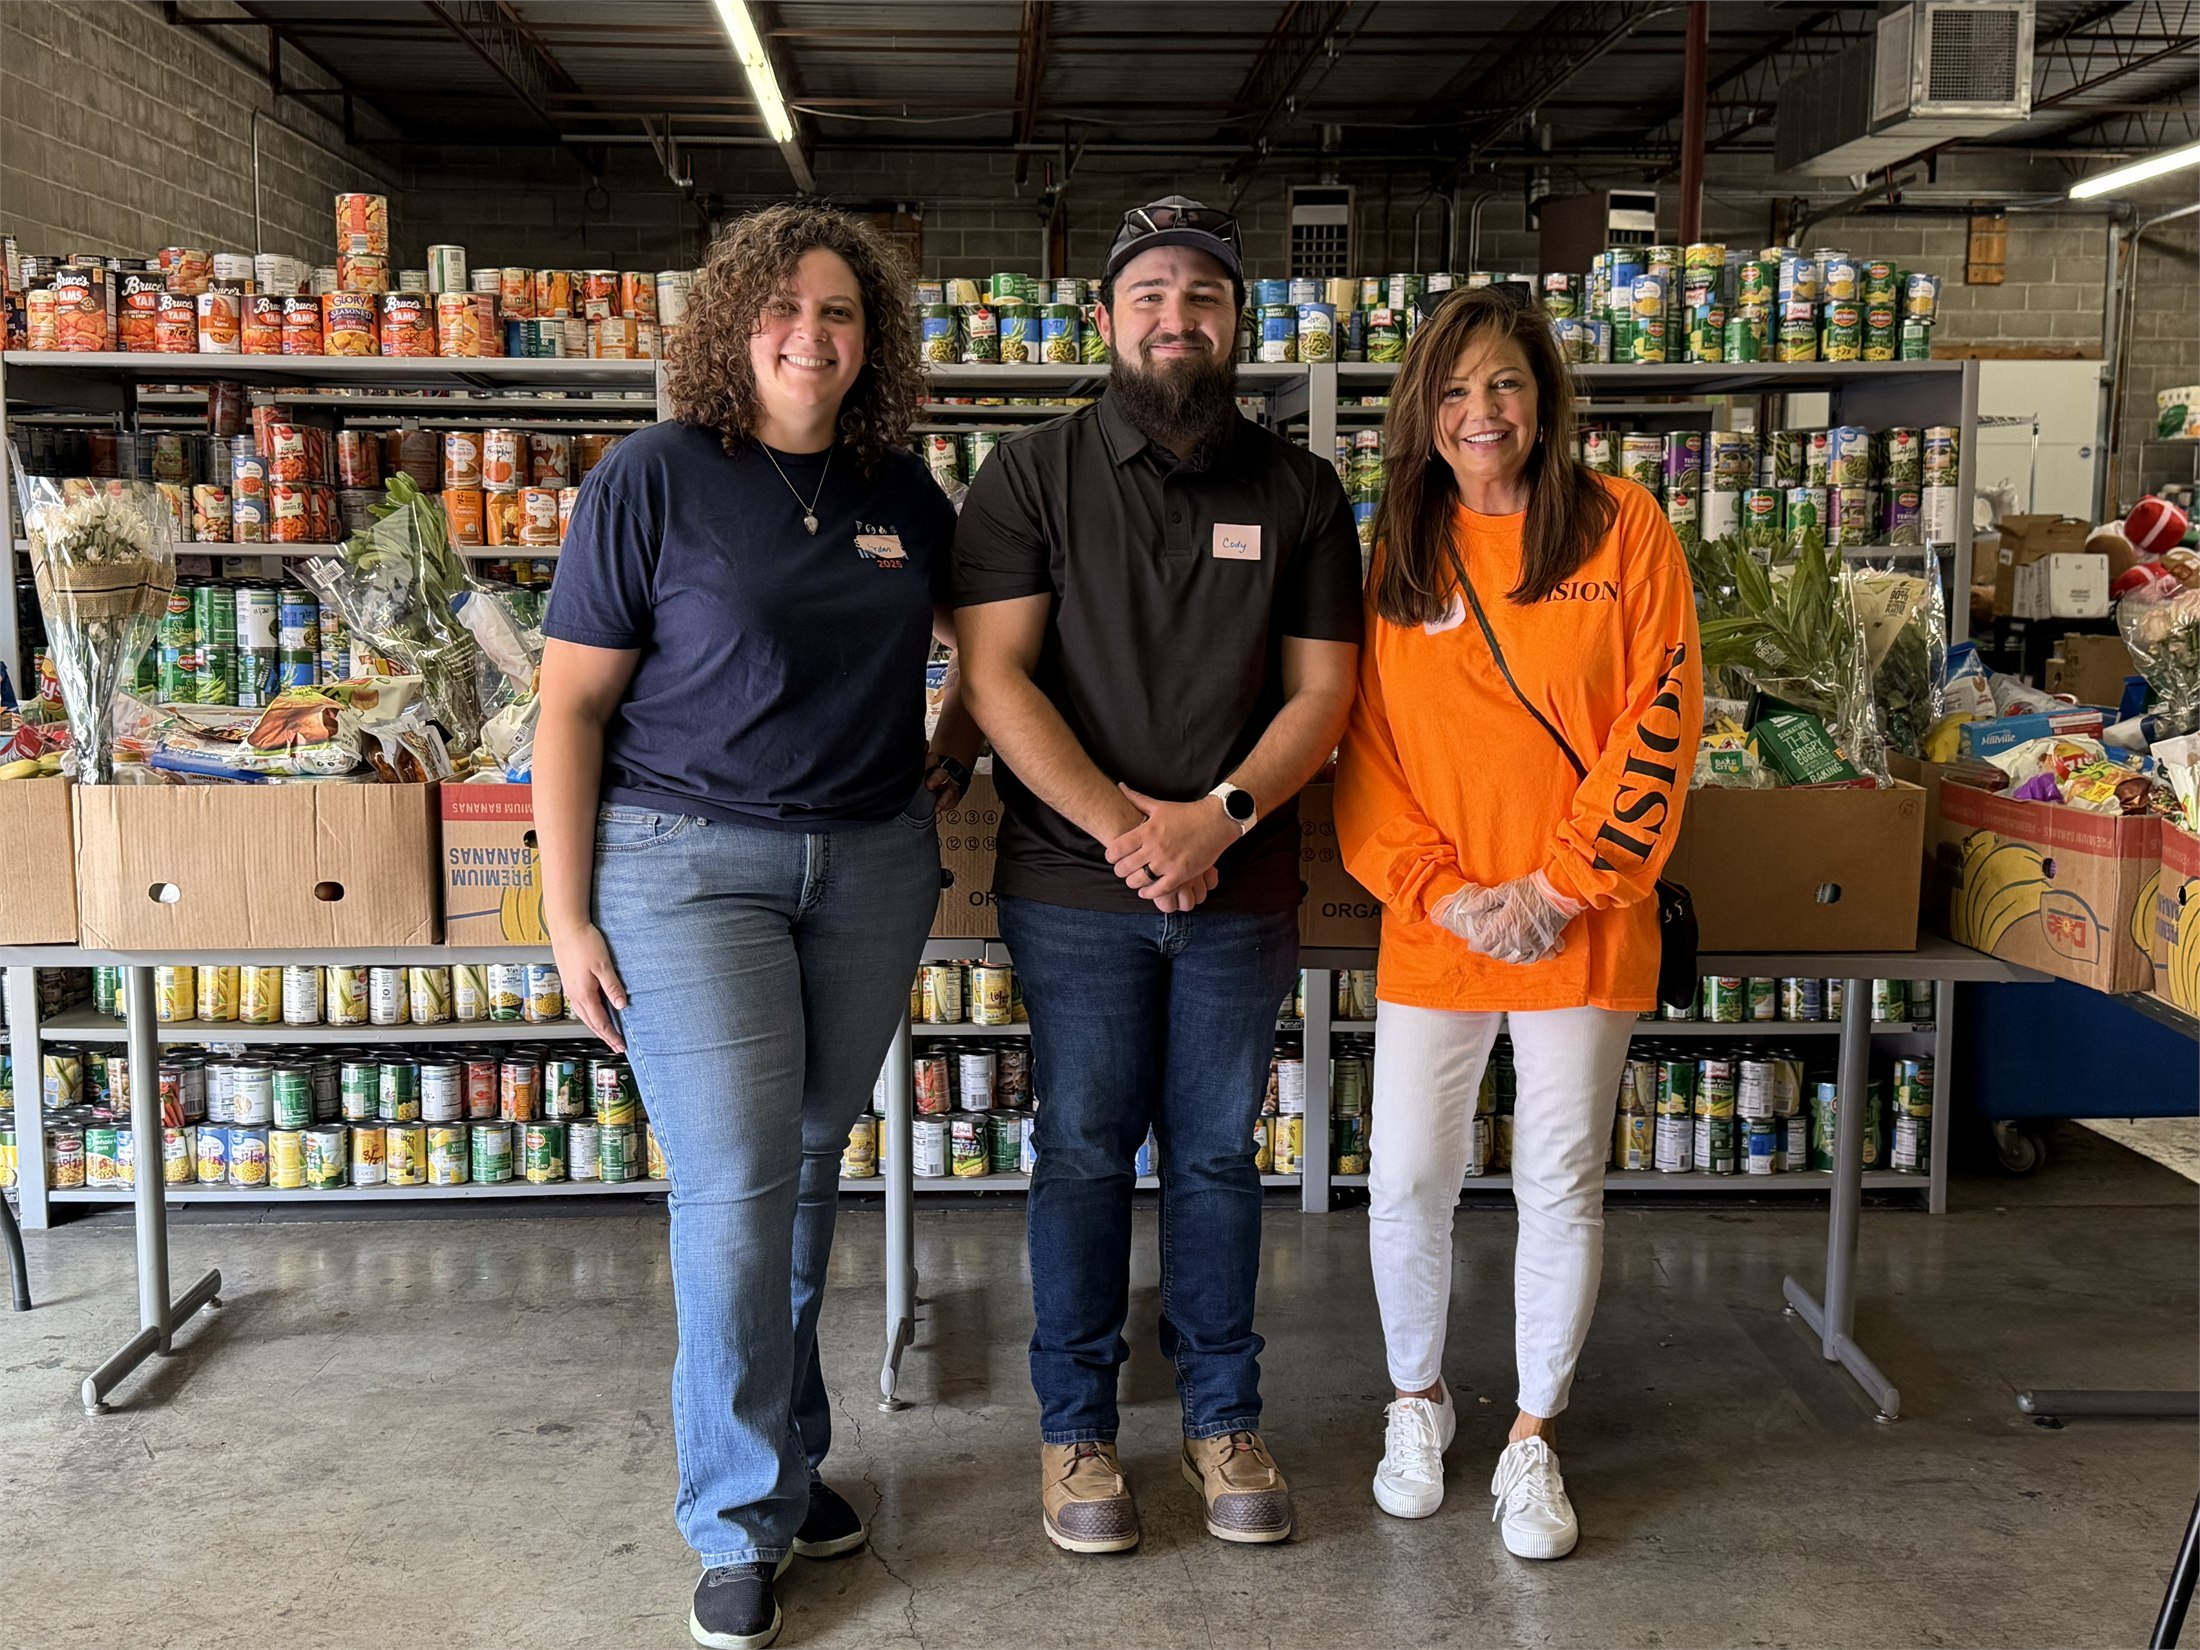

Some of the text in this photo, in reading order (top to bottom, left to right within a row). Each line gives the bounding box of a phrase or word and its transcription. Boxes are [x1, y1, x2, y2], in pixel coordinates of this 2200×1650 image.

[122, 275, 165, 296] Bruce's
[135, 295, 155, 307] YAM
[159, 295, 194, 311] Bruce's
[254, 297, 281, 314] Bruc
[283, 298, 319, 314] Bruce's
[333, 295, 369, 307] GLORY
[384, 296, 421, 313] Bruce's
[167, 311, 191, 320] YAMS
[265, 313, 281, 323] YAM
[290, 313, 314, 323] YAMS
[329, 308, 372, 320] SEASONED
[392, 312, 416, 321] YAMS
[1222, 536, 1247, 554] Cody
[877, 559, 903, 568] 2025
[1544, 581, 1620, 603] ISION
[1778, 720, 1810, 740] SIGNATURE
[1782, 727, 1818, 750] THIN
[1982, 734, 2016, 746] Millville
[1592, 642, 1686, 871] ISION
[1791, 737, 1824, 760] CRISPY
[1797, 746, 1830, 766] COOKIES
[1715, 758, 1737, 766] BAKE
[1809, 763, 1843, 784] BAKING
[452, 803, 533, 814] MIUM BANANAS
[449, 848, 532, 865] BANANAS
[451, 869, 533, 886] PREMIUM
[969, 891, 998, 907] OR
[1322, 903, 1381, 918] ORGA
[356, 1169, 375, 1177] Corn
